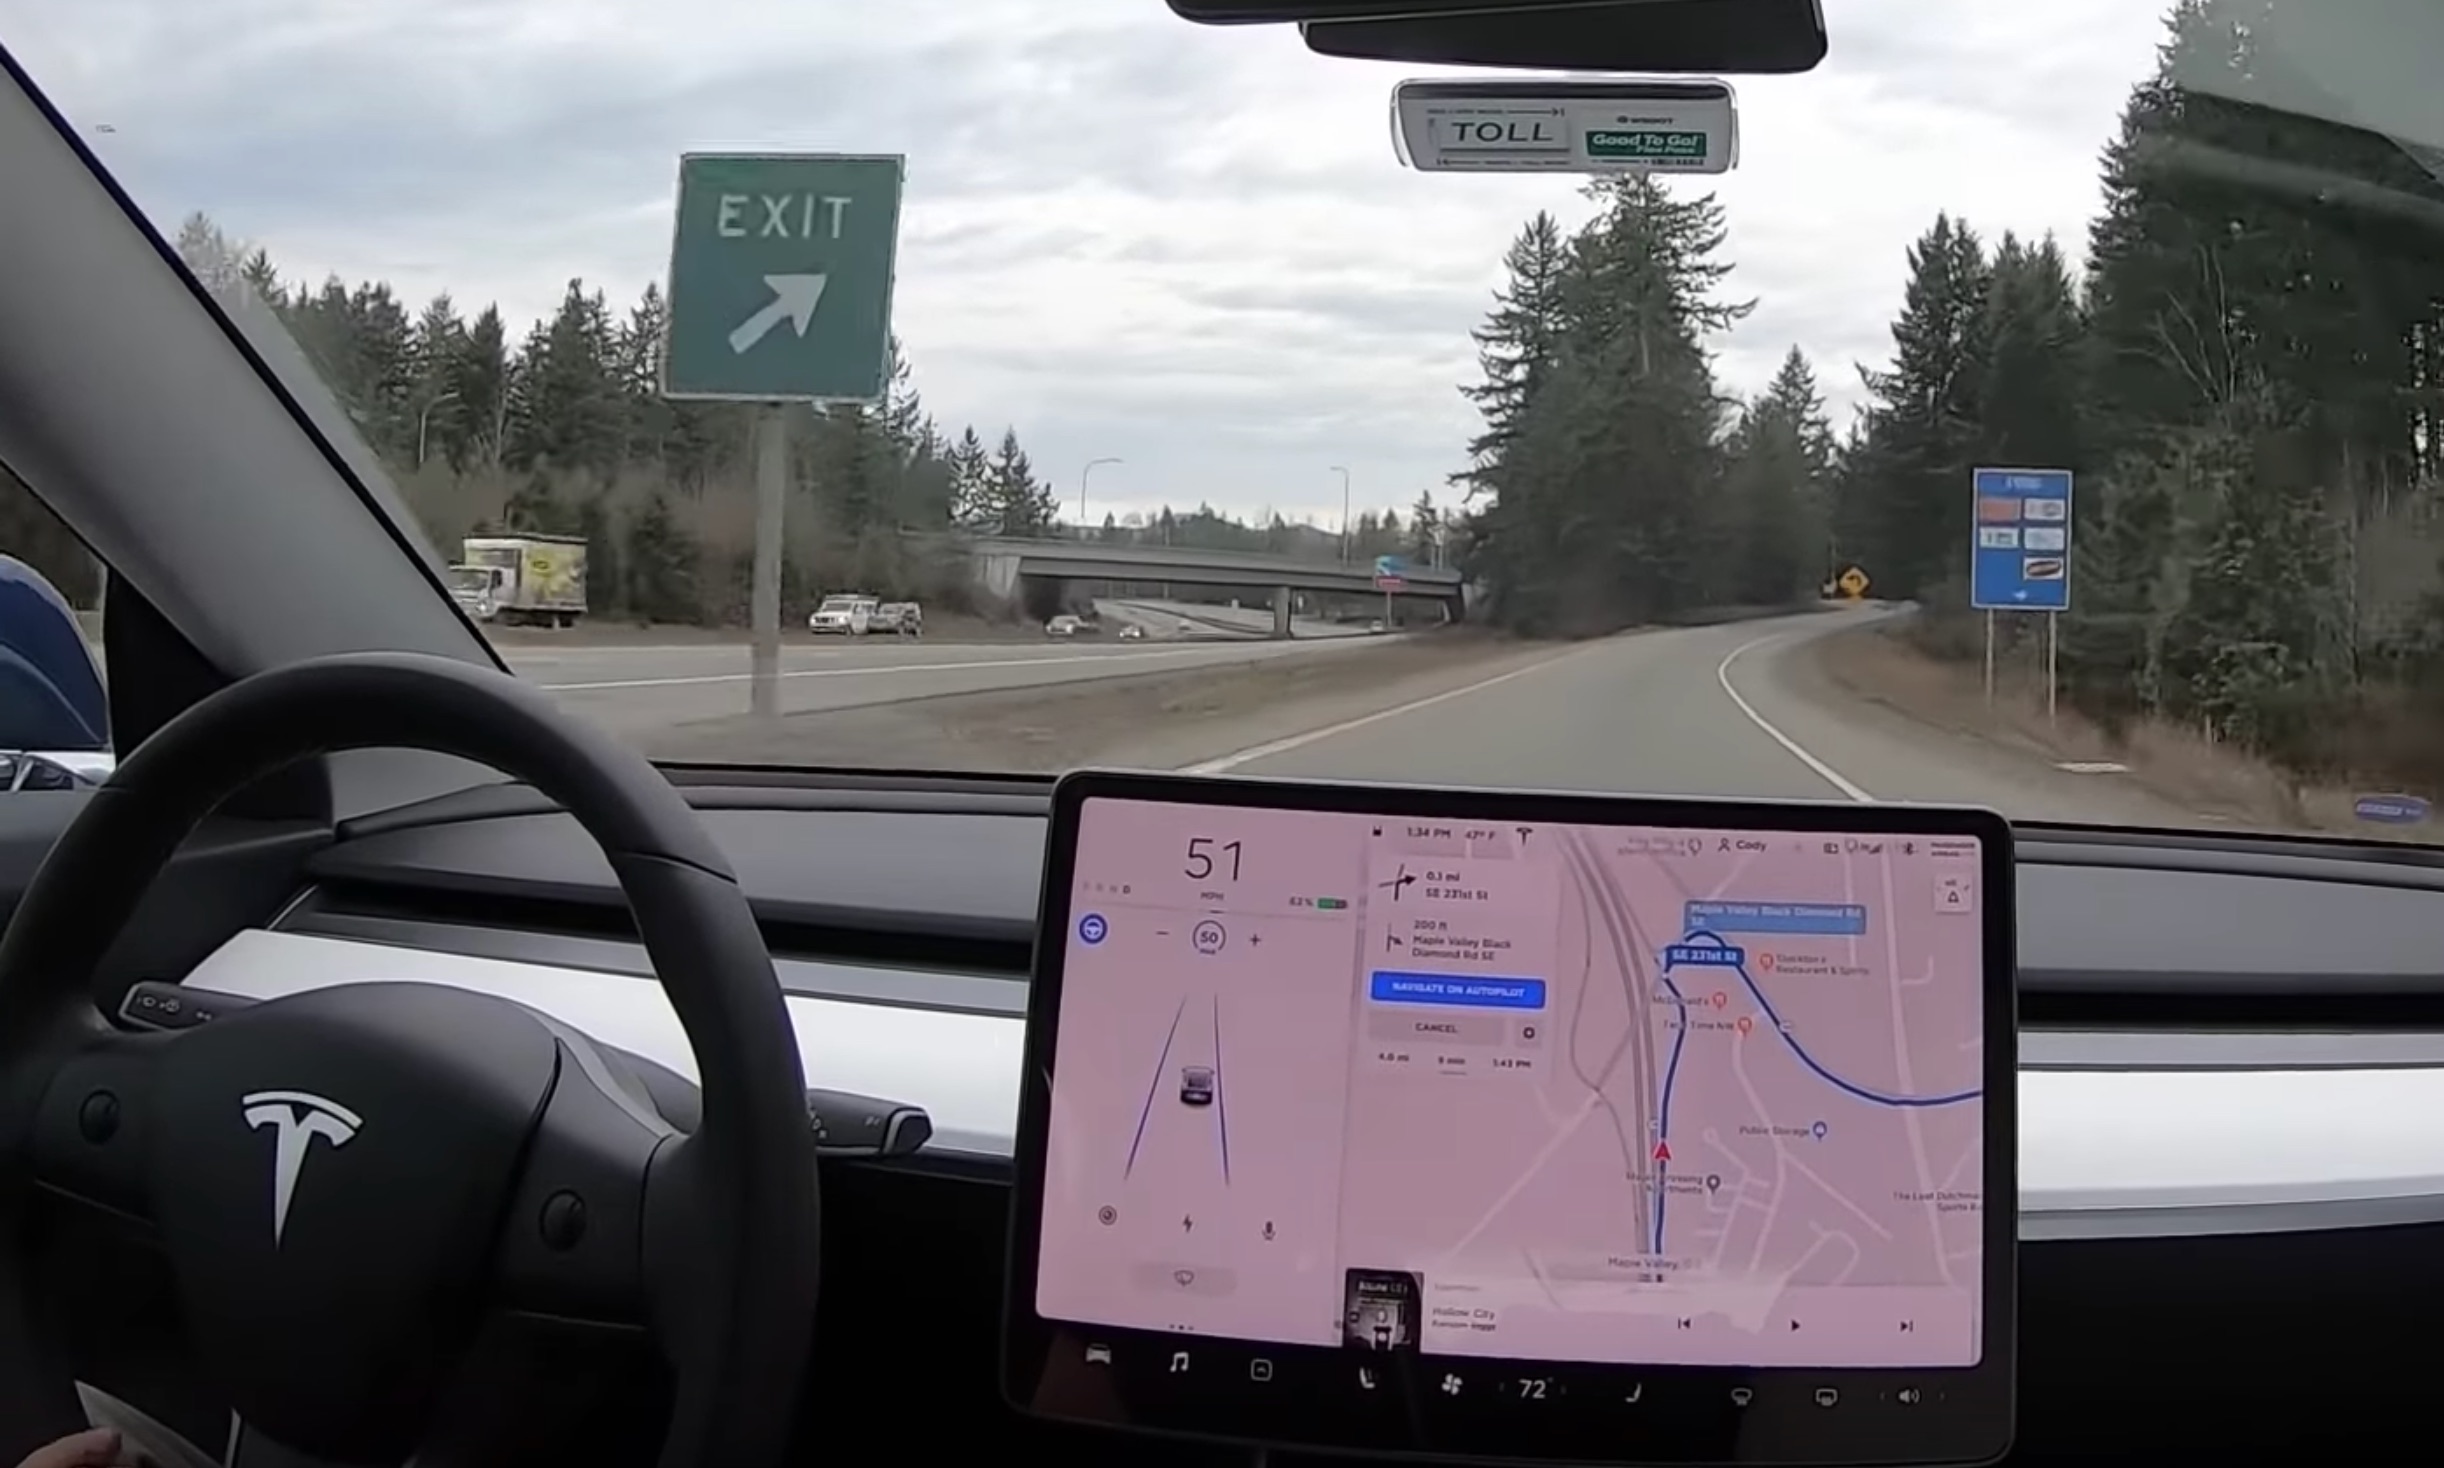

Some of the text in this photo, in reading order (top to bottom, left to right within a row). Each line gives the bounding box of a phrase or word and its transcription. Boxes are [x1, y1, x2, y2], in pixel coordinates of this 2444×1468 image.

[1451, 121, 1554, 142] TOLL
[1592, 133, 1699, 147] Good To Go!
[718, 194, 853, 239] EXIT
[1406, 826, 1452, 839] 1:34 PM
[1488, 831, 1496, 841] F
[1735, 839, 1767, 852] Cody
[1184, 837, 1242, 881] 51
[1445, 871, 1460, 882] mi
[1122, 884, 1131, 895] D
[1200, 891, 1225, 901] MPH
[1413, 919, 1437, 931] 200
[1200, 931, 1220, 945] 50
[1412, 935, 1512, 950] Maple Valley Black
[1411, 947, 1461, 960] Diamond
[1480, 951, 1495, 961] SE
[1391, 981, 1527, 998] NAVIGATE ON AUTOPILOT
[1652, 995, 1709, 1007] McDald's
[1414, 1021, 1459, 1035] CANCEL
